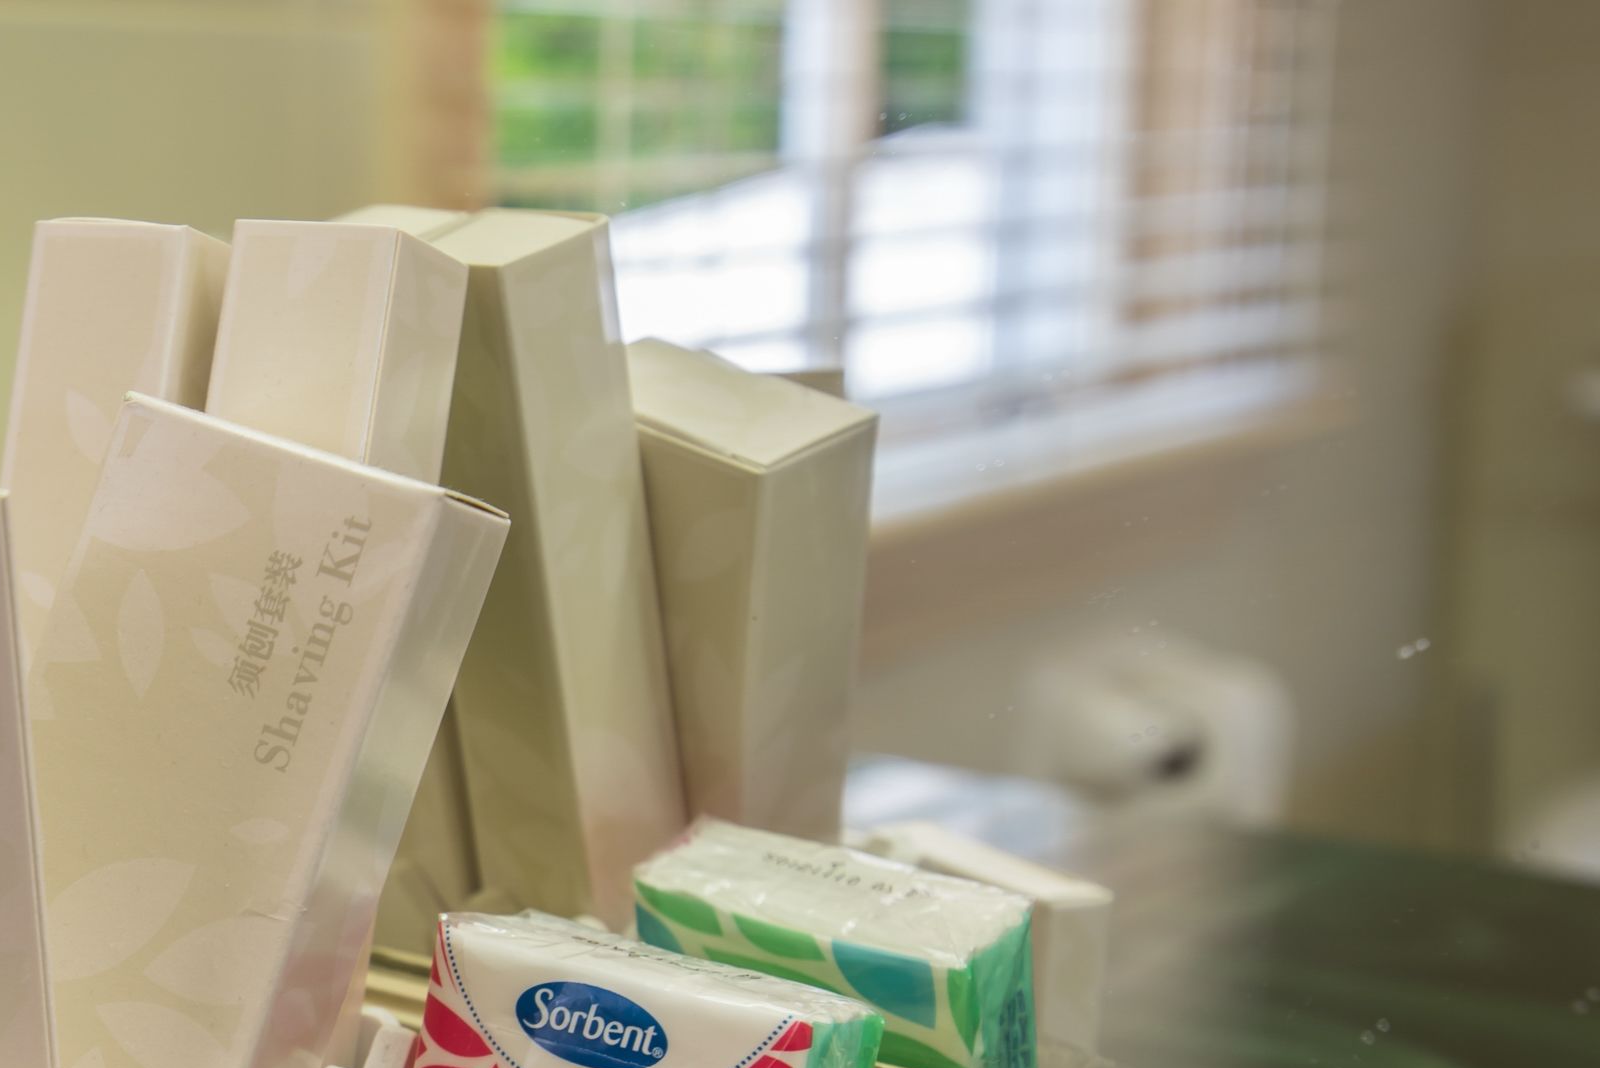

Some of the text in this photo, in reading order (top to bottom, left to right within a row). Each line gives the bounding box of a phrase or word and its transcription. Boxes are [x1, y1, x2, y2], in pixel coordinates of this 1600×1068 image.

[227, 549, 303, 699] 须刨套装
[254, 514, 372, 774] Shaving Kit
